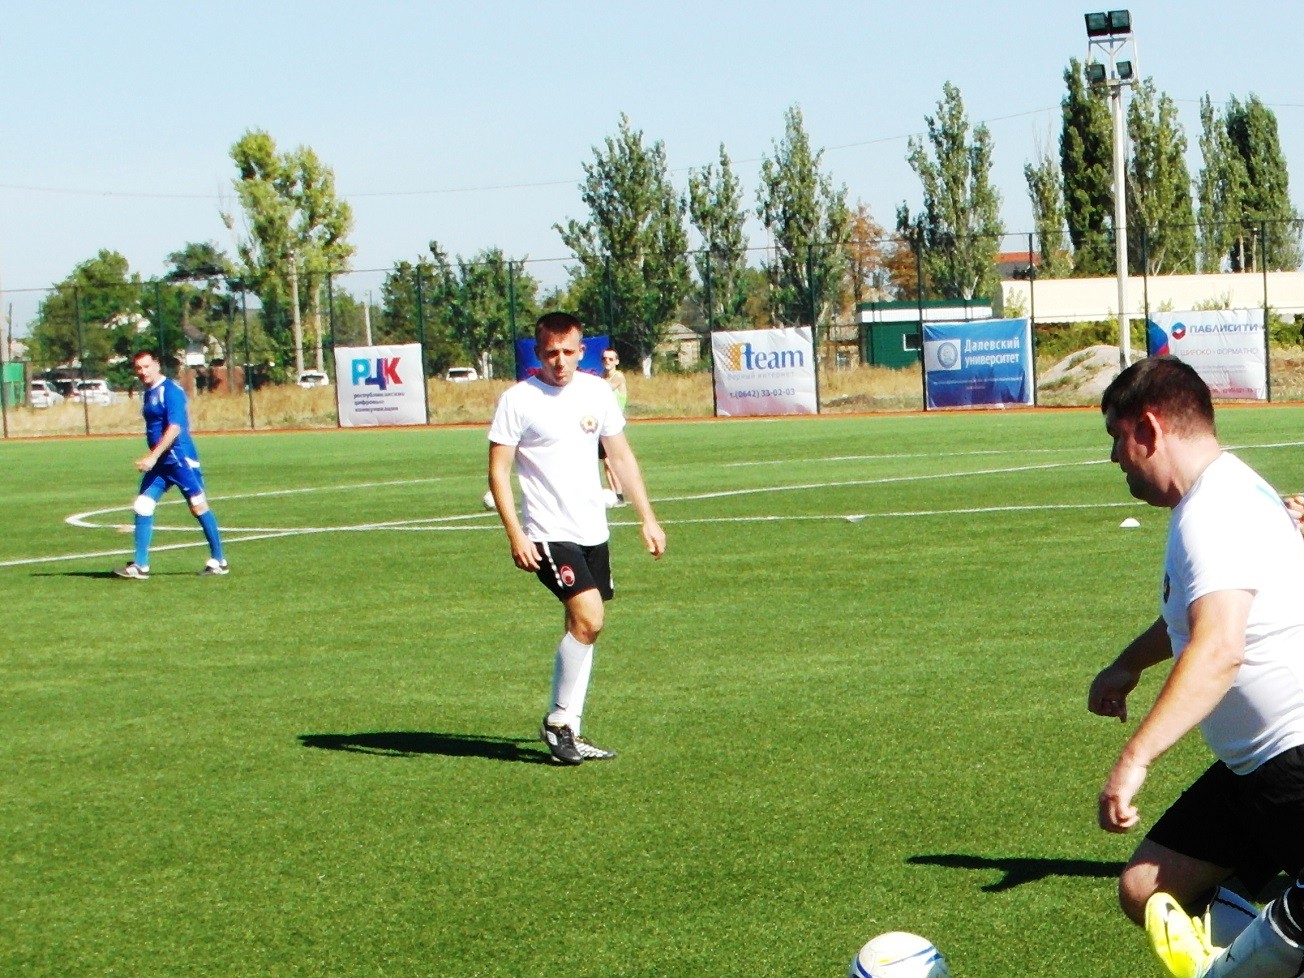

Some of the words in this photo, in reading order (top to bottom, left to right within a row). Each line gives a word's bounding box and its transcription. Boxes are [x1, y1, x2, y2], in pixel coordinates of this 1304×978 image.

[1190, 324, 1258, 333] ПАБЛИСИТИ
[965, 337, 1020, 353] Далевский
[965, 353, 1020, 368] университет
